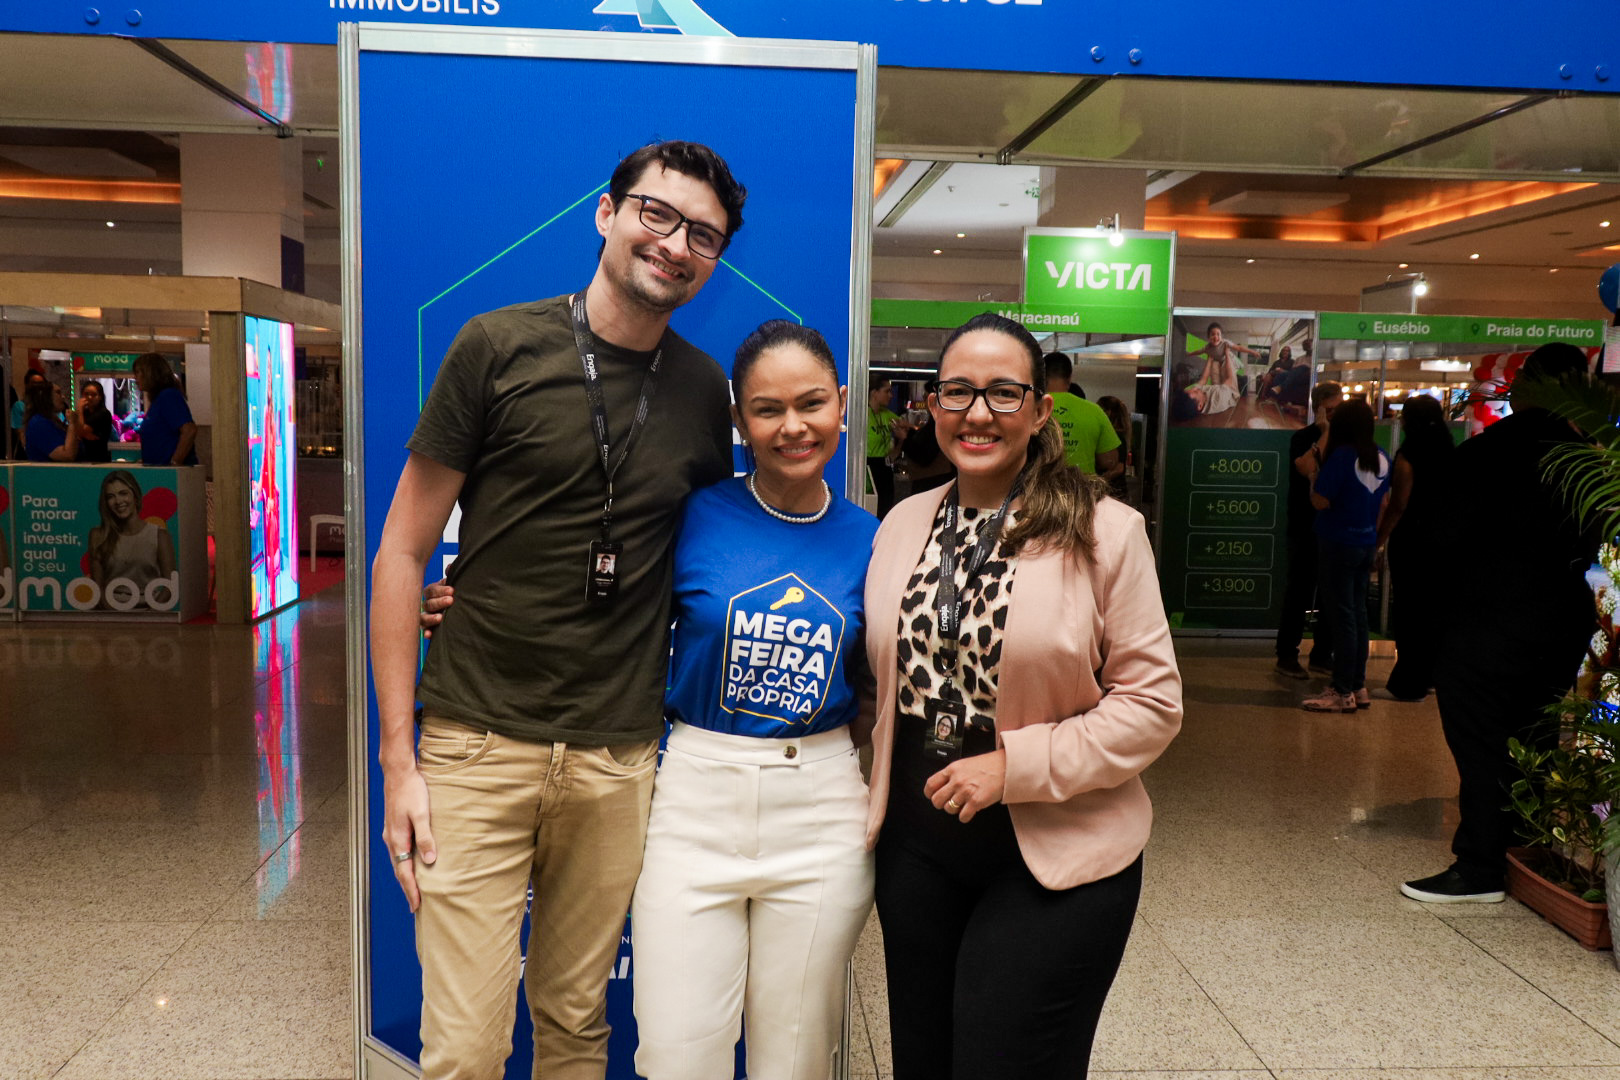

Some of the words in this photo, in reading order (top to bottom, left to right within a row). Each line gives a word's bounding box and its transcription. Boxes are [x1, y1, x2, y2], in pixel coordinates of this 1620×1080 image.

[1045, 260, 1152, 291] VICTA
[998, 310, 1080, 326] Maracanaú
[1373, 321, 1431, 335] Eusébio
[1487, 323, 1523, 337] Praia
[1526, 325, 1545, 338] do
[1547, 325, 1594, 338] Futuro
[94, 354, 128, 364] mood
[1209, 458, 1263, 474] +8.000
[22, 495, 59, 508] Para
[31, 509, 78, 521] morar
[32, 521, 52, 532] ou
[23, 532, 82, 546] investir,
[23, 548, 57, 563] qual
[24, 562, 34, 573] o
[38, 562, 66, 573] seu
[18, 571, 180, 612] mood
[733, 610, 833, 652] MEGA
[730, 638, 825, 680] FEIRA
[729, 664, 756, 684] DA
[762, 668, 820, 699] CASA
[726, 682, 812, 715] PRÓPRIA
